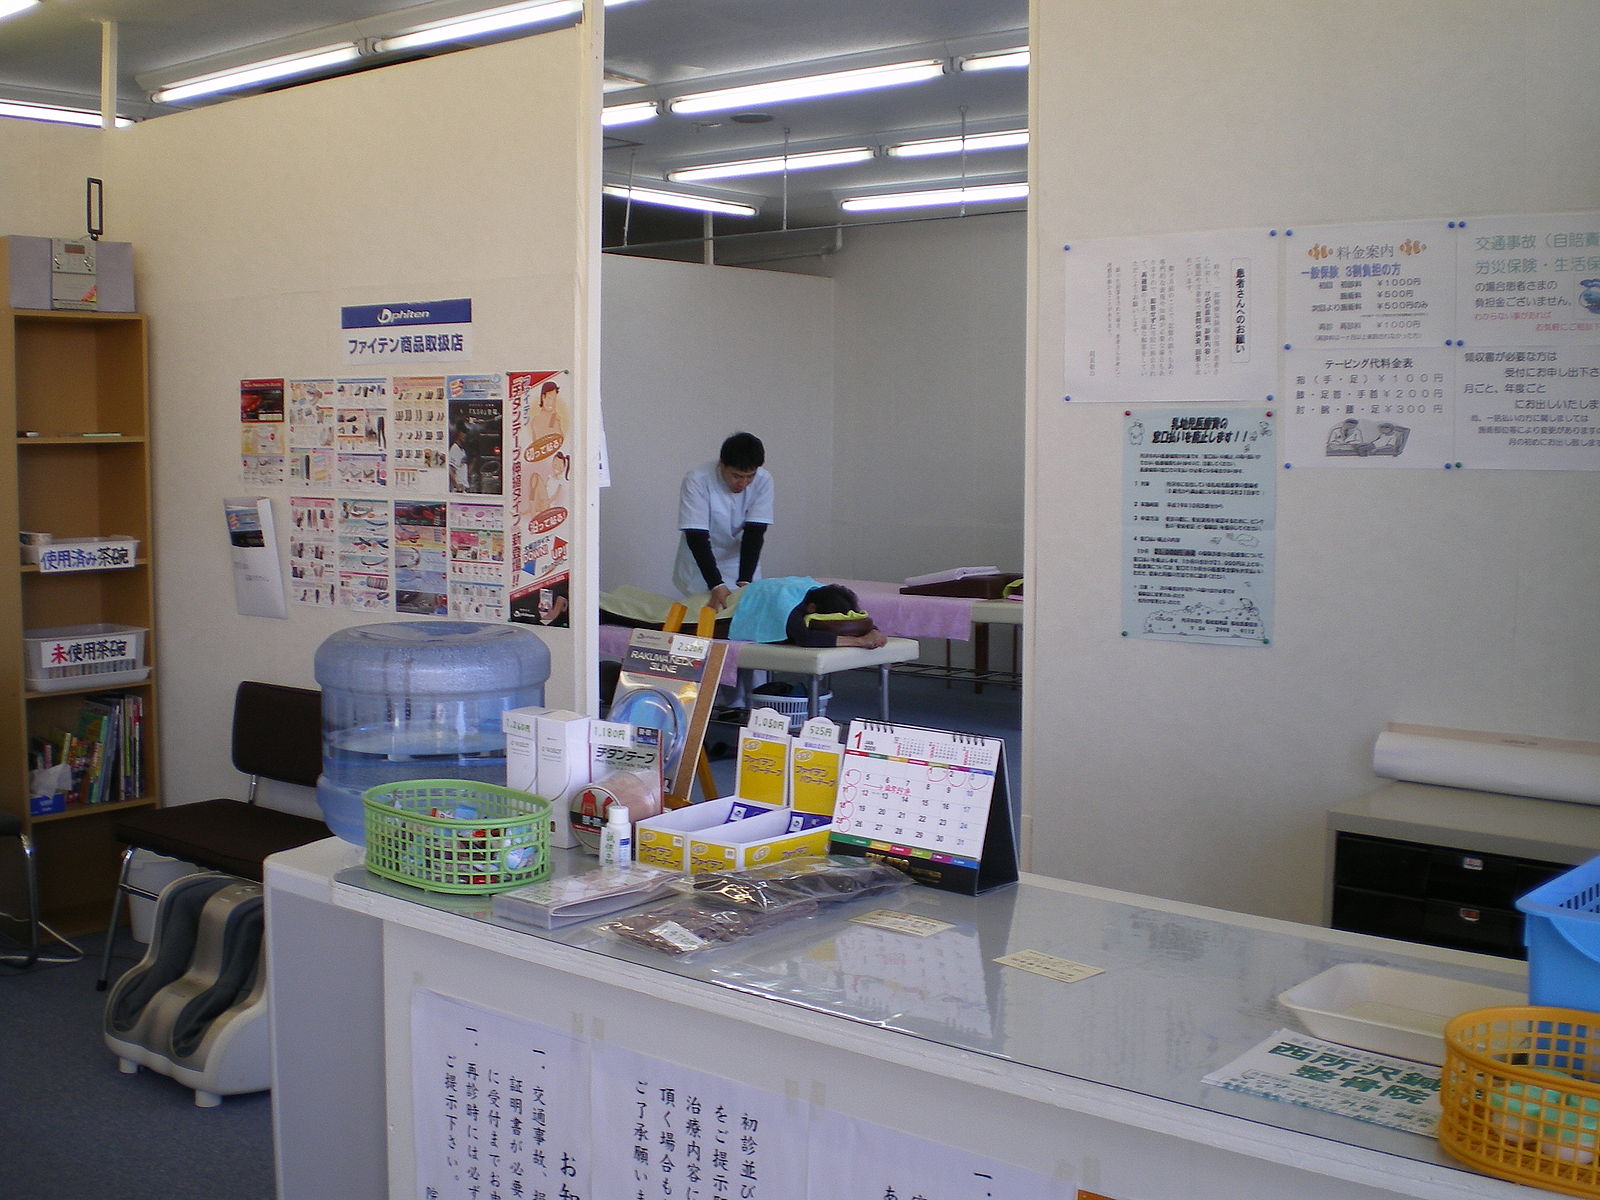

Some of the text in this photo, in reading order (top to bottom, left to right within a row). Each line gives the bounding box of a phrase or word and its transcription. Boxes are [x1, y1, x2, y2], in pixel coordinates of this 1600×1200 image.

[1337, 244, 1394, 260] 料金案内
[348, 333, 465, 356] ファイテン商品取扱店
[41, 546, 129, 570] 使用済み茶碗
[51, 640, 127, 664] 未使用茶碗
[594, 726, 626, 741] 1,180円
[754, 715, 785, 730] 1,050円
[809, 725, 833, 738] 525円
[854, 732, 864, 750] 1
[596, 746, 655, 764] チタンテープ
[876, 824, 883, 832] 27
[937, 835, 944, 843] 30
[1289, 1064, 1432, 1105] 整骨院
[659, 1087, 676, 1196] 頂く場合も
[686, 1095, 702, 1200] 治療内容に
[713, 1105, 730, 1200] をご提示
[740, 1113, 759, 1200] 初診並び
